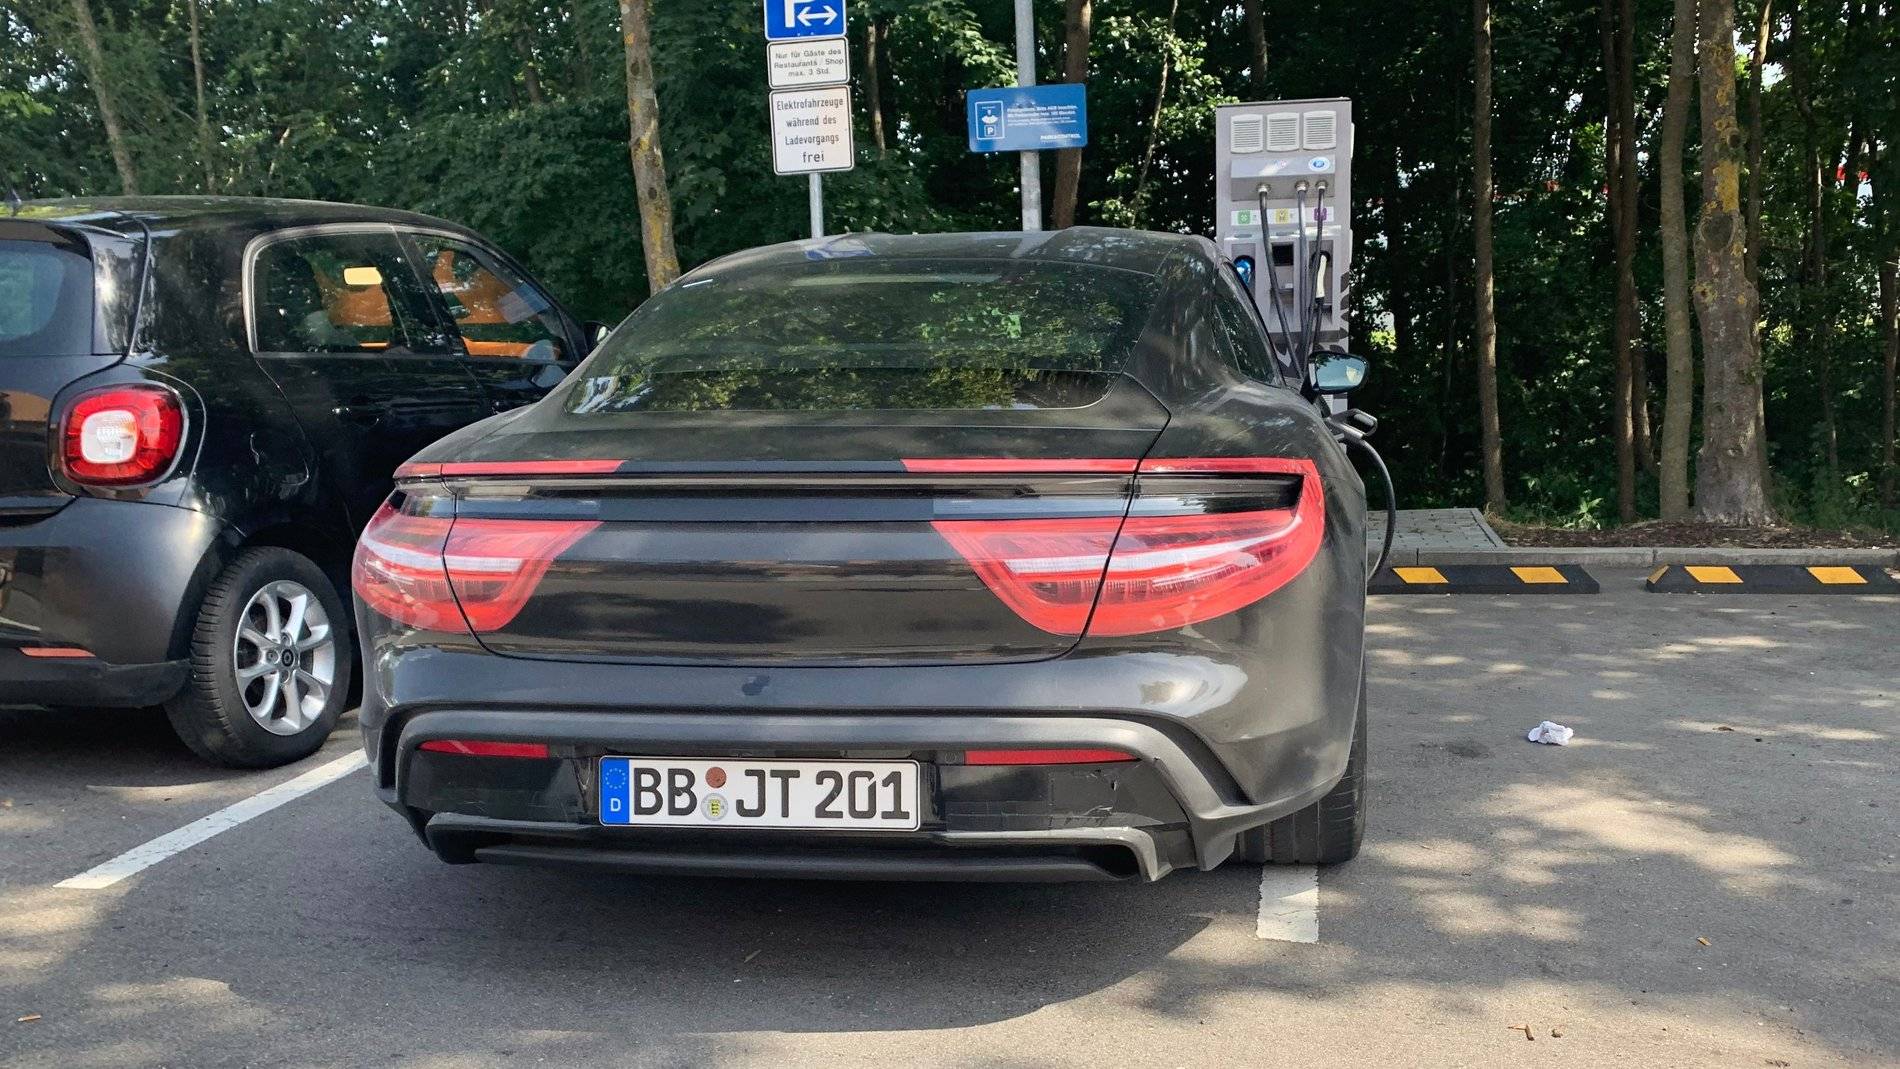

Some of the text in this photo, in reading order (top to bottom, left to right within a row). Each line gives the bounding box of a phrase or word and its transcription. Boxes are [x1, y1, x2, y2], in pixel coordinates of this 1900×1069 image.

[776, 98, 844, 111] Elektrofahrzeuge
[786, 115, 837, 127] während des
[785, 134, 840, 146] Ladevorgangs
[802, 151, 825, 163] frei
[633, 767, 910, 819] BB JT 201
[610, 797, 621, 812] D
